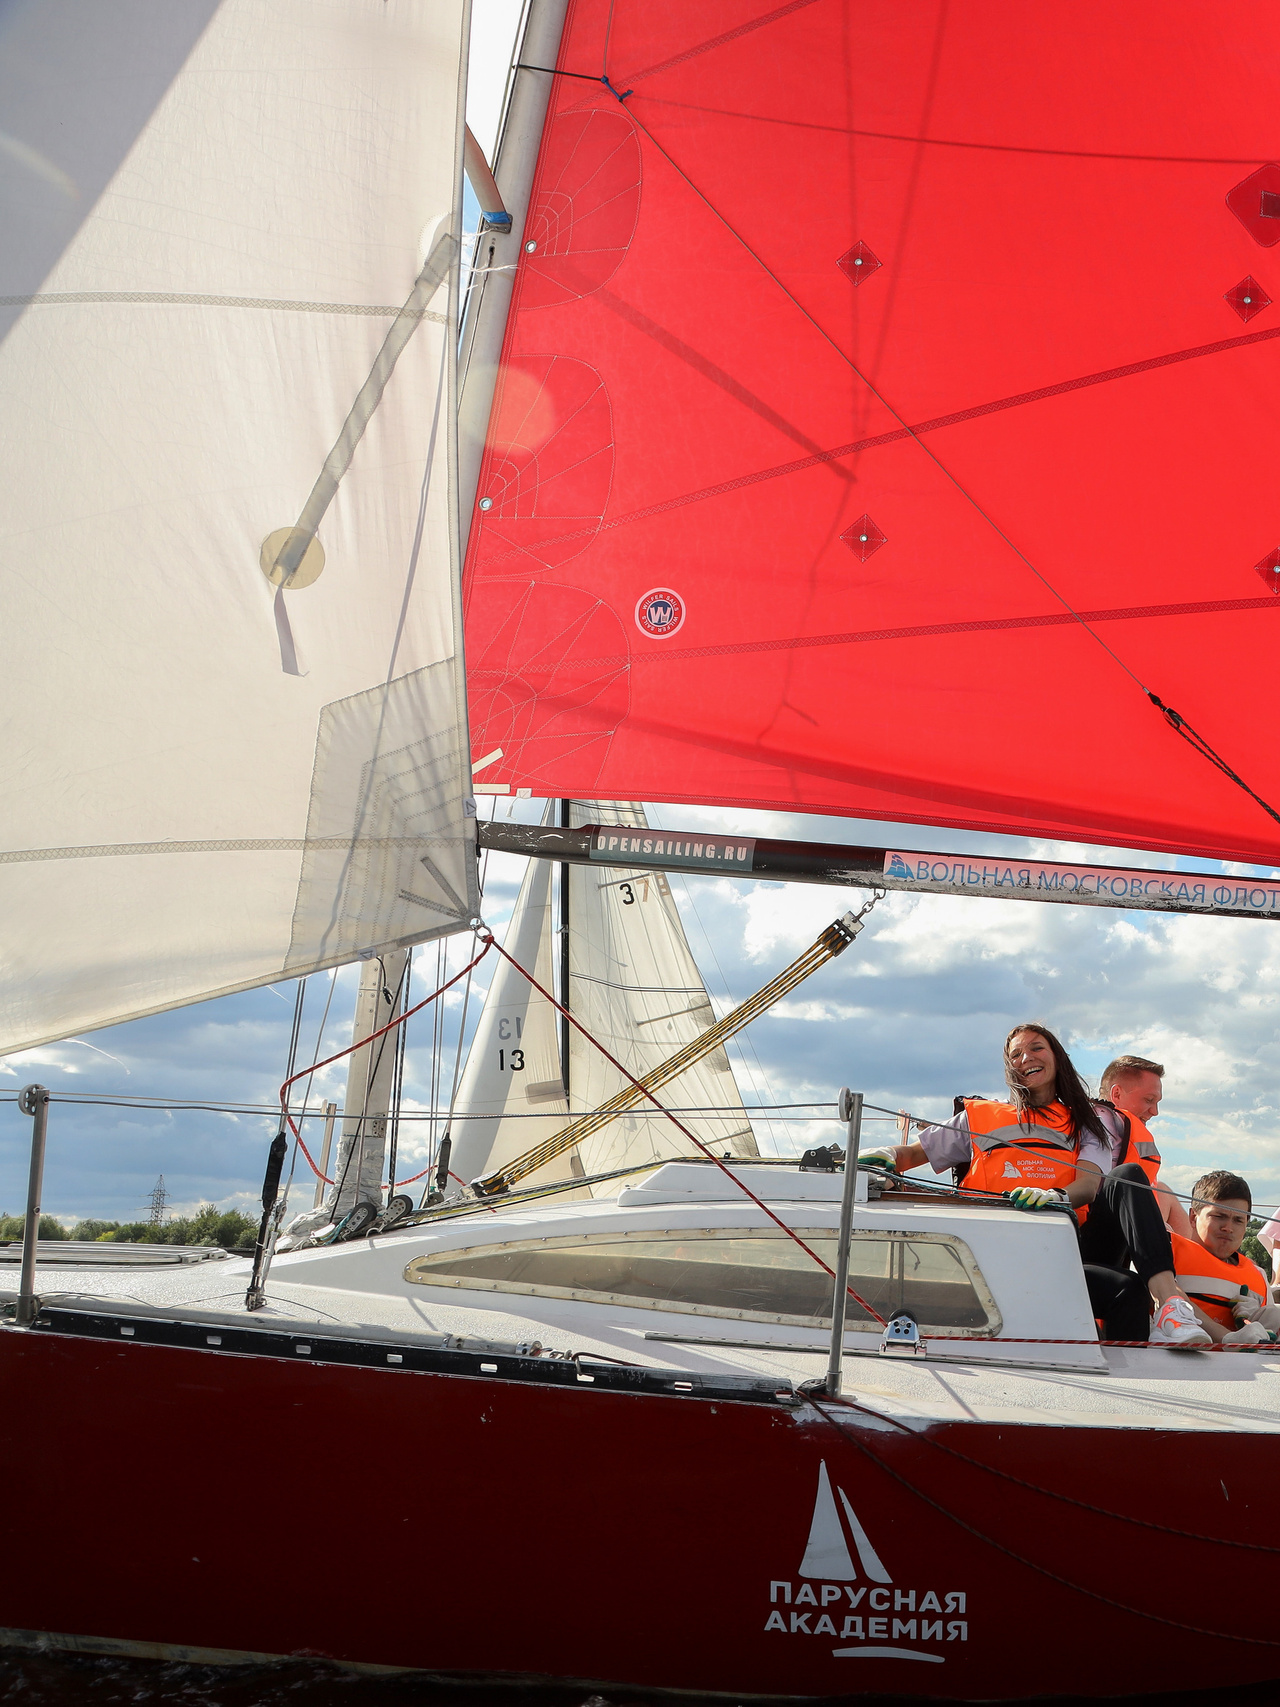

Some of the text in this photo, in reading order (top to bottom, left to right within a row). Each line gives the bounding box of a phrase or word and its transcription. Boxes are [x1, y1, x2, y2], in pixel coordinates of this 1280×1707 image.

[642, 594, 679, 612] WILFER SAILS
[641, 615, 679, 632] WILFER SAILS
[597, 835, 748, 861] OPENSAILING.RU
[916, 860, 1031, 888] ВОЛЬНАЯ
[1038, 869, 1206, 903] МОСКОВСКАЯ
[499, 1048, 525, 1071] 13
[769, 1580, 967, 1614] ПАРУСНАЯ
[763, 1610, 968, 1641] АКАДЕМИЯ
